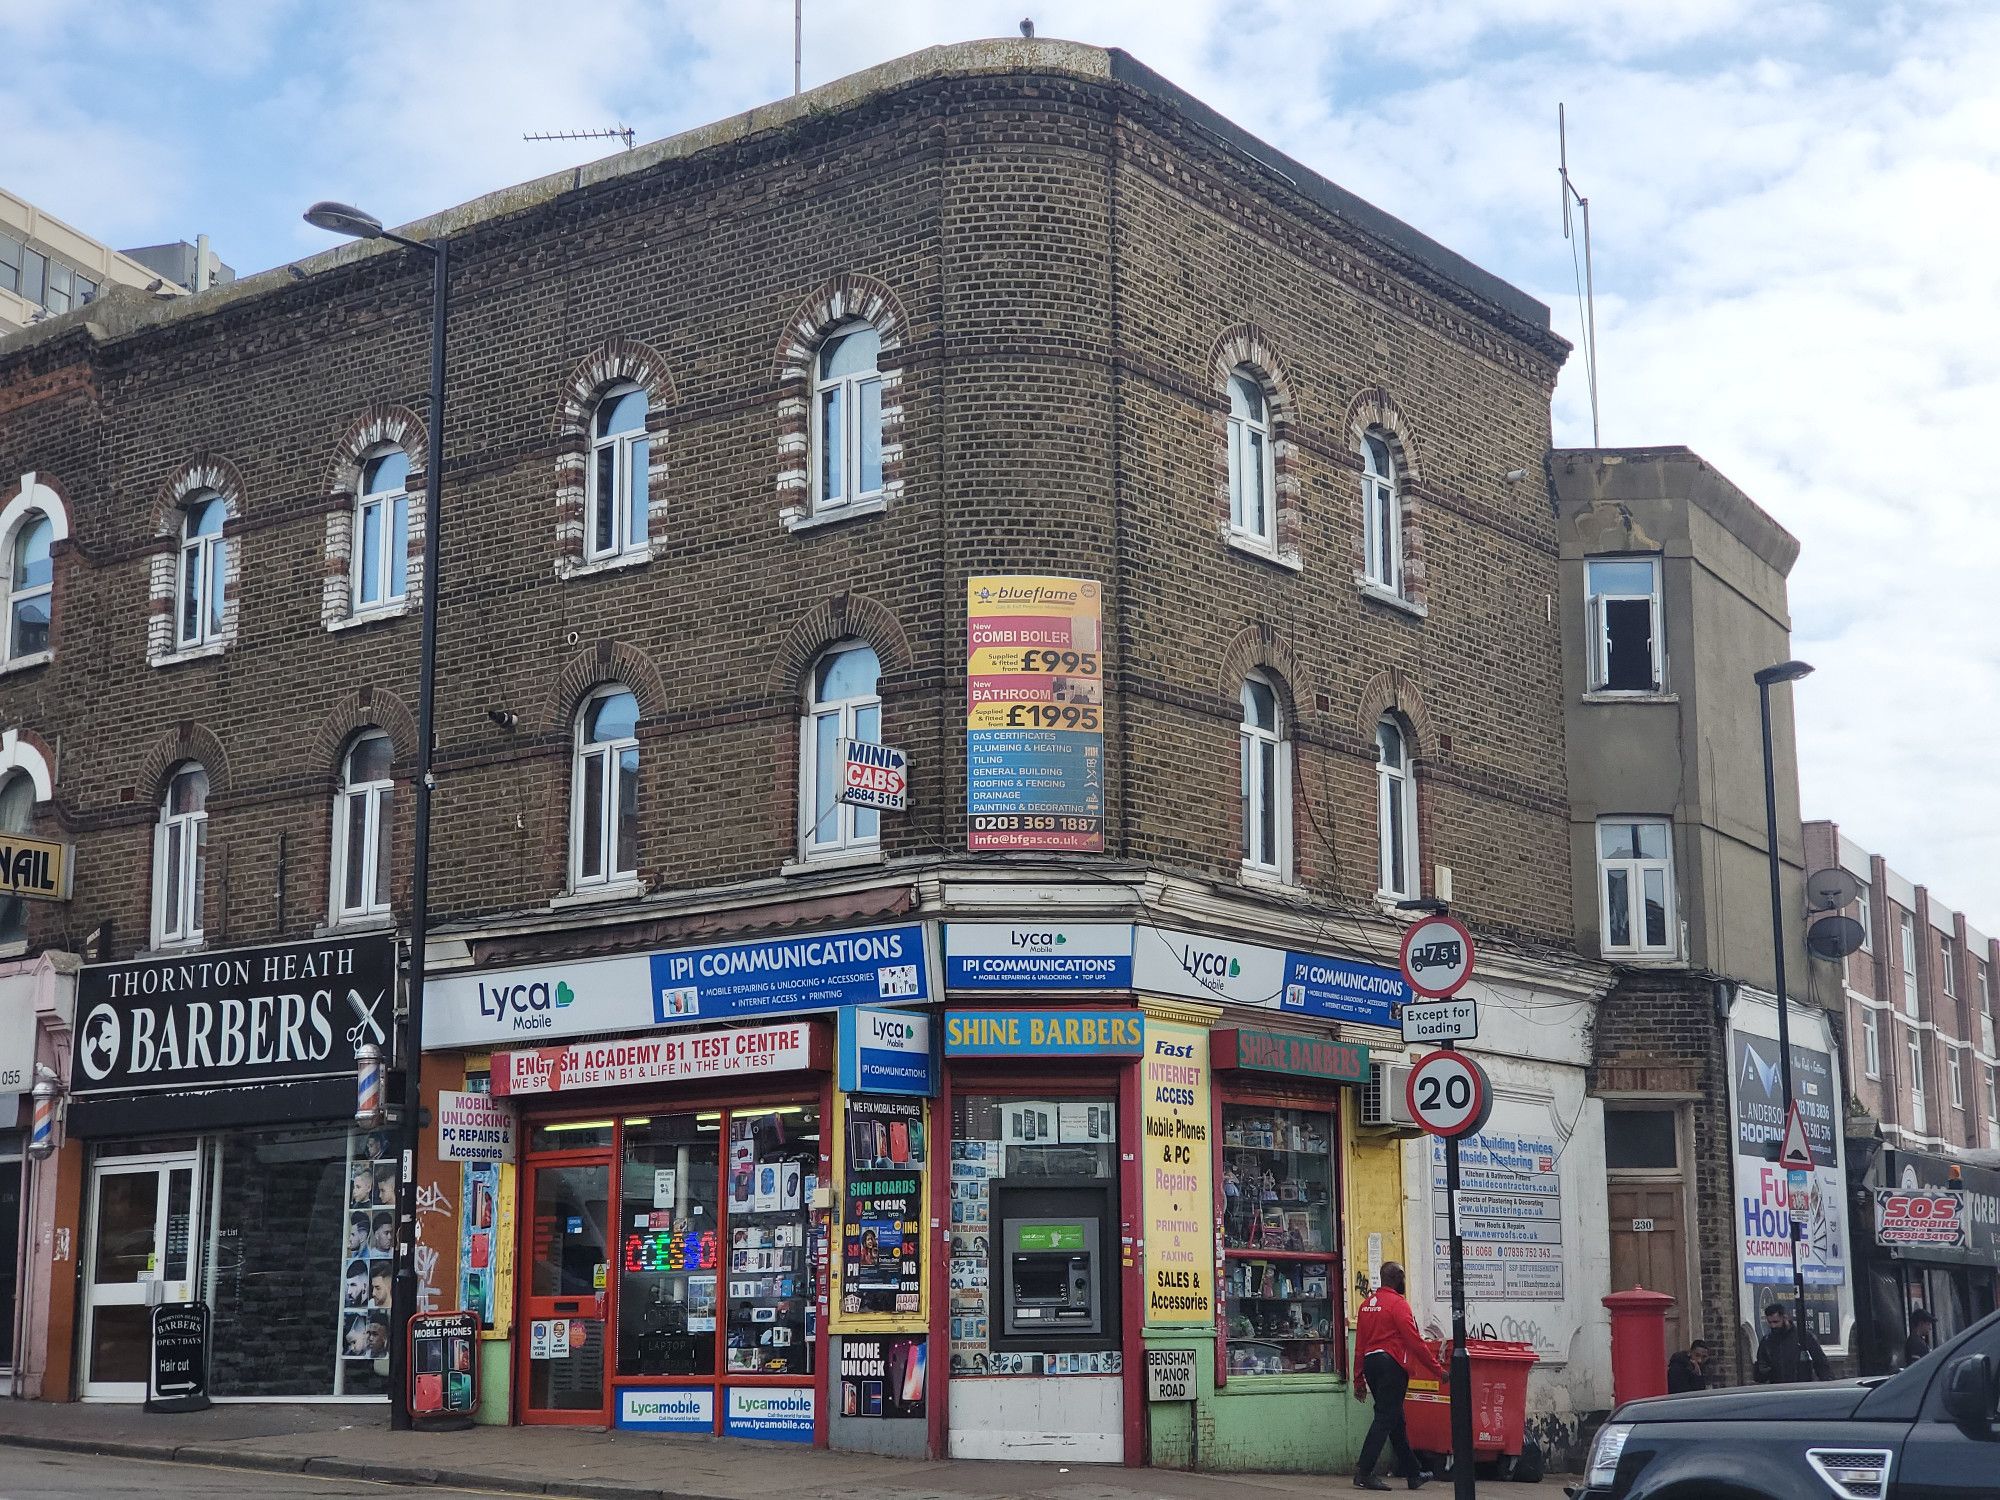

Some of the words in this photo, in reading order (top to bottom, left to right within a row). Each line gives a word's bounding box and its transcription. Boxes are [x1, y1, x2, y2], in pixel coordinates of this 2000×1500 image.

[998, 587, 1078, 603] blueflame
[973, 632, 1016, 642] COMBI
[1020, 631, 1070, 643] BOILER
[1021, 650, 1097, 674] £995
[972, 690, 1050, 700] BATHROOM
[1006, 704, 1098, 730] £1995
[994, 732, 1056, 740] CERTIFICATES
[848, 742, 892, 768] MINI
[974, 744, 1022, 752] PLUMBING
[847, 764, 901, 794] CABS
[1020, 768, 1062, 776] BUILDING
[848, 786, 874, 803] 8684
[878, 792, 904, 808] 5151
[974, 792, 1020, 800] DRAINAGE
[1028, 804, 1084, 812] DECORATING
[976, 817, 1018, 830] 0203
[1024, 816, 1054, 829] 369
[1060, 818, 1096, 832] 1887
[974, 835, 1078, 845] info@bfgas.co.uk
[1012, 930, 1052, 948] Lyca
[670, 957, 694, 980] IPI
[700, 935, 902, 978] COMMUNICATIONS
[1184, 944, 1226, 978] Lyca
[1427, 946, 1448, 962] 7.5
[1452, 944, 1458, 956] t
[108, 959, 250, 998] THORNTON
[262, 948, 354, 984] HEATH
[963, 960, 979, 972] IPI
[983, 960, 1116, 972] COMMUNICATIONS
[706, 985, 732, 996] MOBILE
[733, 981, 769, 994] REPAIRING
[777, 978, 820, 990] UNLOCKING
[828, 973, 874, 985] ACCESSORIES
[1200, 977, 1224, 990] Mobile
[1310, 967, 1402, 996] COMMUNICATIONS
[480, 981, 550, 1021] Lyca
[738, 996, 770, 1007] INTERNET
[772, 994, 798, 1004] ACCESS
[809, 990, 842, 1001] PRINTING
[1408, 1008, 1448, 1021] Except
[1452, 1006, 1470, 1018] for
[513, 1014, 552, 1030] Mobile
[873, 1017, 904, 1040] Lyca
[1417, 1022, 1461, 1035] loading
[127, 989, 333, 1074] BARBERS
[948, 1020, 1021, 1046] SHINE
[1030, 1016, 1141, 1046] BARBERS
[886, 1039, 904, 1048] Mobile
[1155, 1040, 1194, 1058] Fast
[517, 1052, 579, 1076] ENGSH
[585, 1044, 660, 1069] ACADEMY
[666, 1042, 684, 1061] B1
[692, 1036, 730, 1058] TEST
[736, 1030, 799, 1054] CENTRE
[1240, 1034, 1288, 1070] SHINE
[1290, 1042, 1360, 1078] BARBERS
[512, 1078, 529, 1089] WE
[532, 1071, 599, 1087] SPIALISE
[620, 1068, 634, 1080] B1
[650, 1064, 676, 1076] LIFE
[680, 1062, 692, 1074] IN
[696, 1060, 719, 1072] THE
[724, 1058, 740, 1068] UK
[746, 1054, 776, 1067] TEST
[871, 1065, 926, 1078] COMMUNICATIONS
[1148, 1062, 1200, 1086] INTERNET
[1156, 1087, 1194, 1106] ACCESS
[1418, 1074, 1471, 1110] 20
[456, 1096, 498, 1110] MOBILE
[874, 1103, 896, 1114] MOBILE
[897, 1105, 920, 1116] PHONES
[1740, 1101, 1746, 1118] L.
[442, 1111, 510, 1128] UNLOCKING
[442, 1128, 456, 1140] PC
[459, 1130, 500, 1143] REPAIRS
[1146, 1116, 1174, 1138] Mobile
[1176, 1119, 1206, 1140] Phones
[1740, 1122, 1786, 1143] ROOFIN
[450, 1144, 502, 1158] Accessories
[1481, 1136, 1516, 1153] Building
[1518, 1140, 1553, 1154] Services
[1174, 1146, 1190, 1164] PC
[1490, 1152, 1533, 1170] Plastering
[850, 1182, 872, 1197] SIGN
[874, 1180, 916, 1196] BOARDS
[1155, 1168, 1198, 1196] Repairs
[1518, 1199, 1544, 1208] Decorating
[1884, 1196, 1958, 1220] SOS
[1156, 1219, 1198, 1233] PRINTING
[1486, 1221, 1502, 1229] Roofs
[1507, 1222, 1525, 1230] Repairs
[1634, 1220, 1652, 1230] 230
[1744, 1198, 1808, 1240] HOUE
[1883, 1218, 1959, 1228] MOTORBIKE
[1462, 1230, 1538, 1240] www.newroofs.co.uk
[1883, 1231, 1958, 1240] 07598434167
[1161, 1251, 1194, 1262] FAXING
[1504, 1248, 1524, 1258] 07836
[1538, 1248, 1550, 1258] 343
[1746, 1240, 1792, 1258] SCAFFOLDIN
[1158, 1271, 1190, 1288] SALES
[1151, 1291, 1208, 1310] Accessories
[158, 1320, 202, 1334] BARBERS
[415, 1328, 442, 1338] MOBILE
[443, 1327, 472, 1336] PHONES
[844, 1342, 880, 1358] PHONE
[160, 1360, 176, 1372] Hair
[178, 1360, 190, 1370] cut
[1149, 1352, 1194, 1366] BENSHAM
[842, 1360, 884, 1376] UNLOCK
[1154, 1368, 1190, 1382] MANOR
[1159, 1384, 1186, 1397] ROAD
[632, 1400, 700, 1416] Lycamobile
[738, 1396, 812, 1412] Lycamobile
[730, 1420, 814, 1430] www.lycamobile.co.
